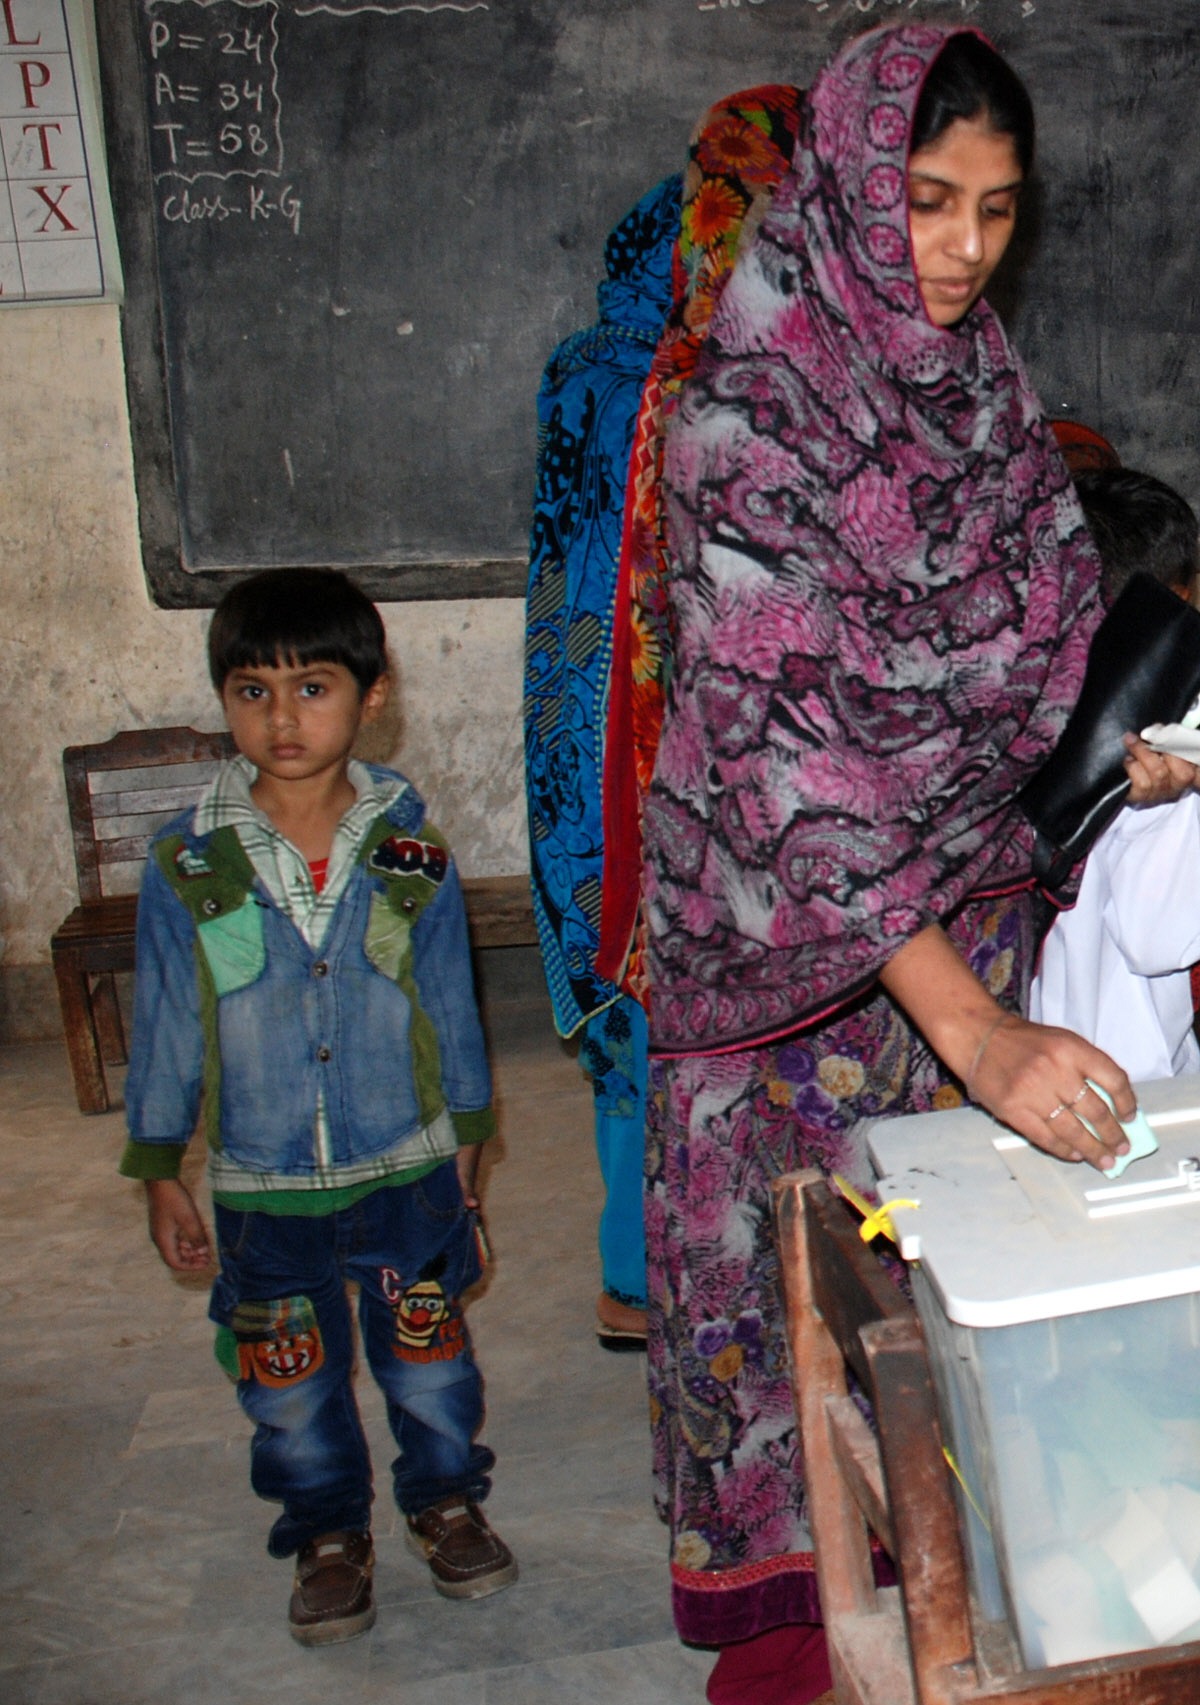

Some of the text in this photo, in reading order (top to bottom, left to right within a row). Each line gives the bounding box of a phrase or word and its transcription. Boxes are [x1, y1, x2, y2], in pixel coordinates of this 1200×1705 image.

[2, 0, 41, 46] L
[217, 27, 264, 65] 24
[15, 61, 51, 109] P
[218, 79, 263, 113] 34
[22, 123, 62, 171] T
[219, 123, 269, 156] 58
[28, 184, 79, 233] X
